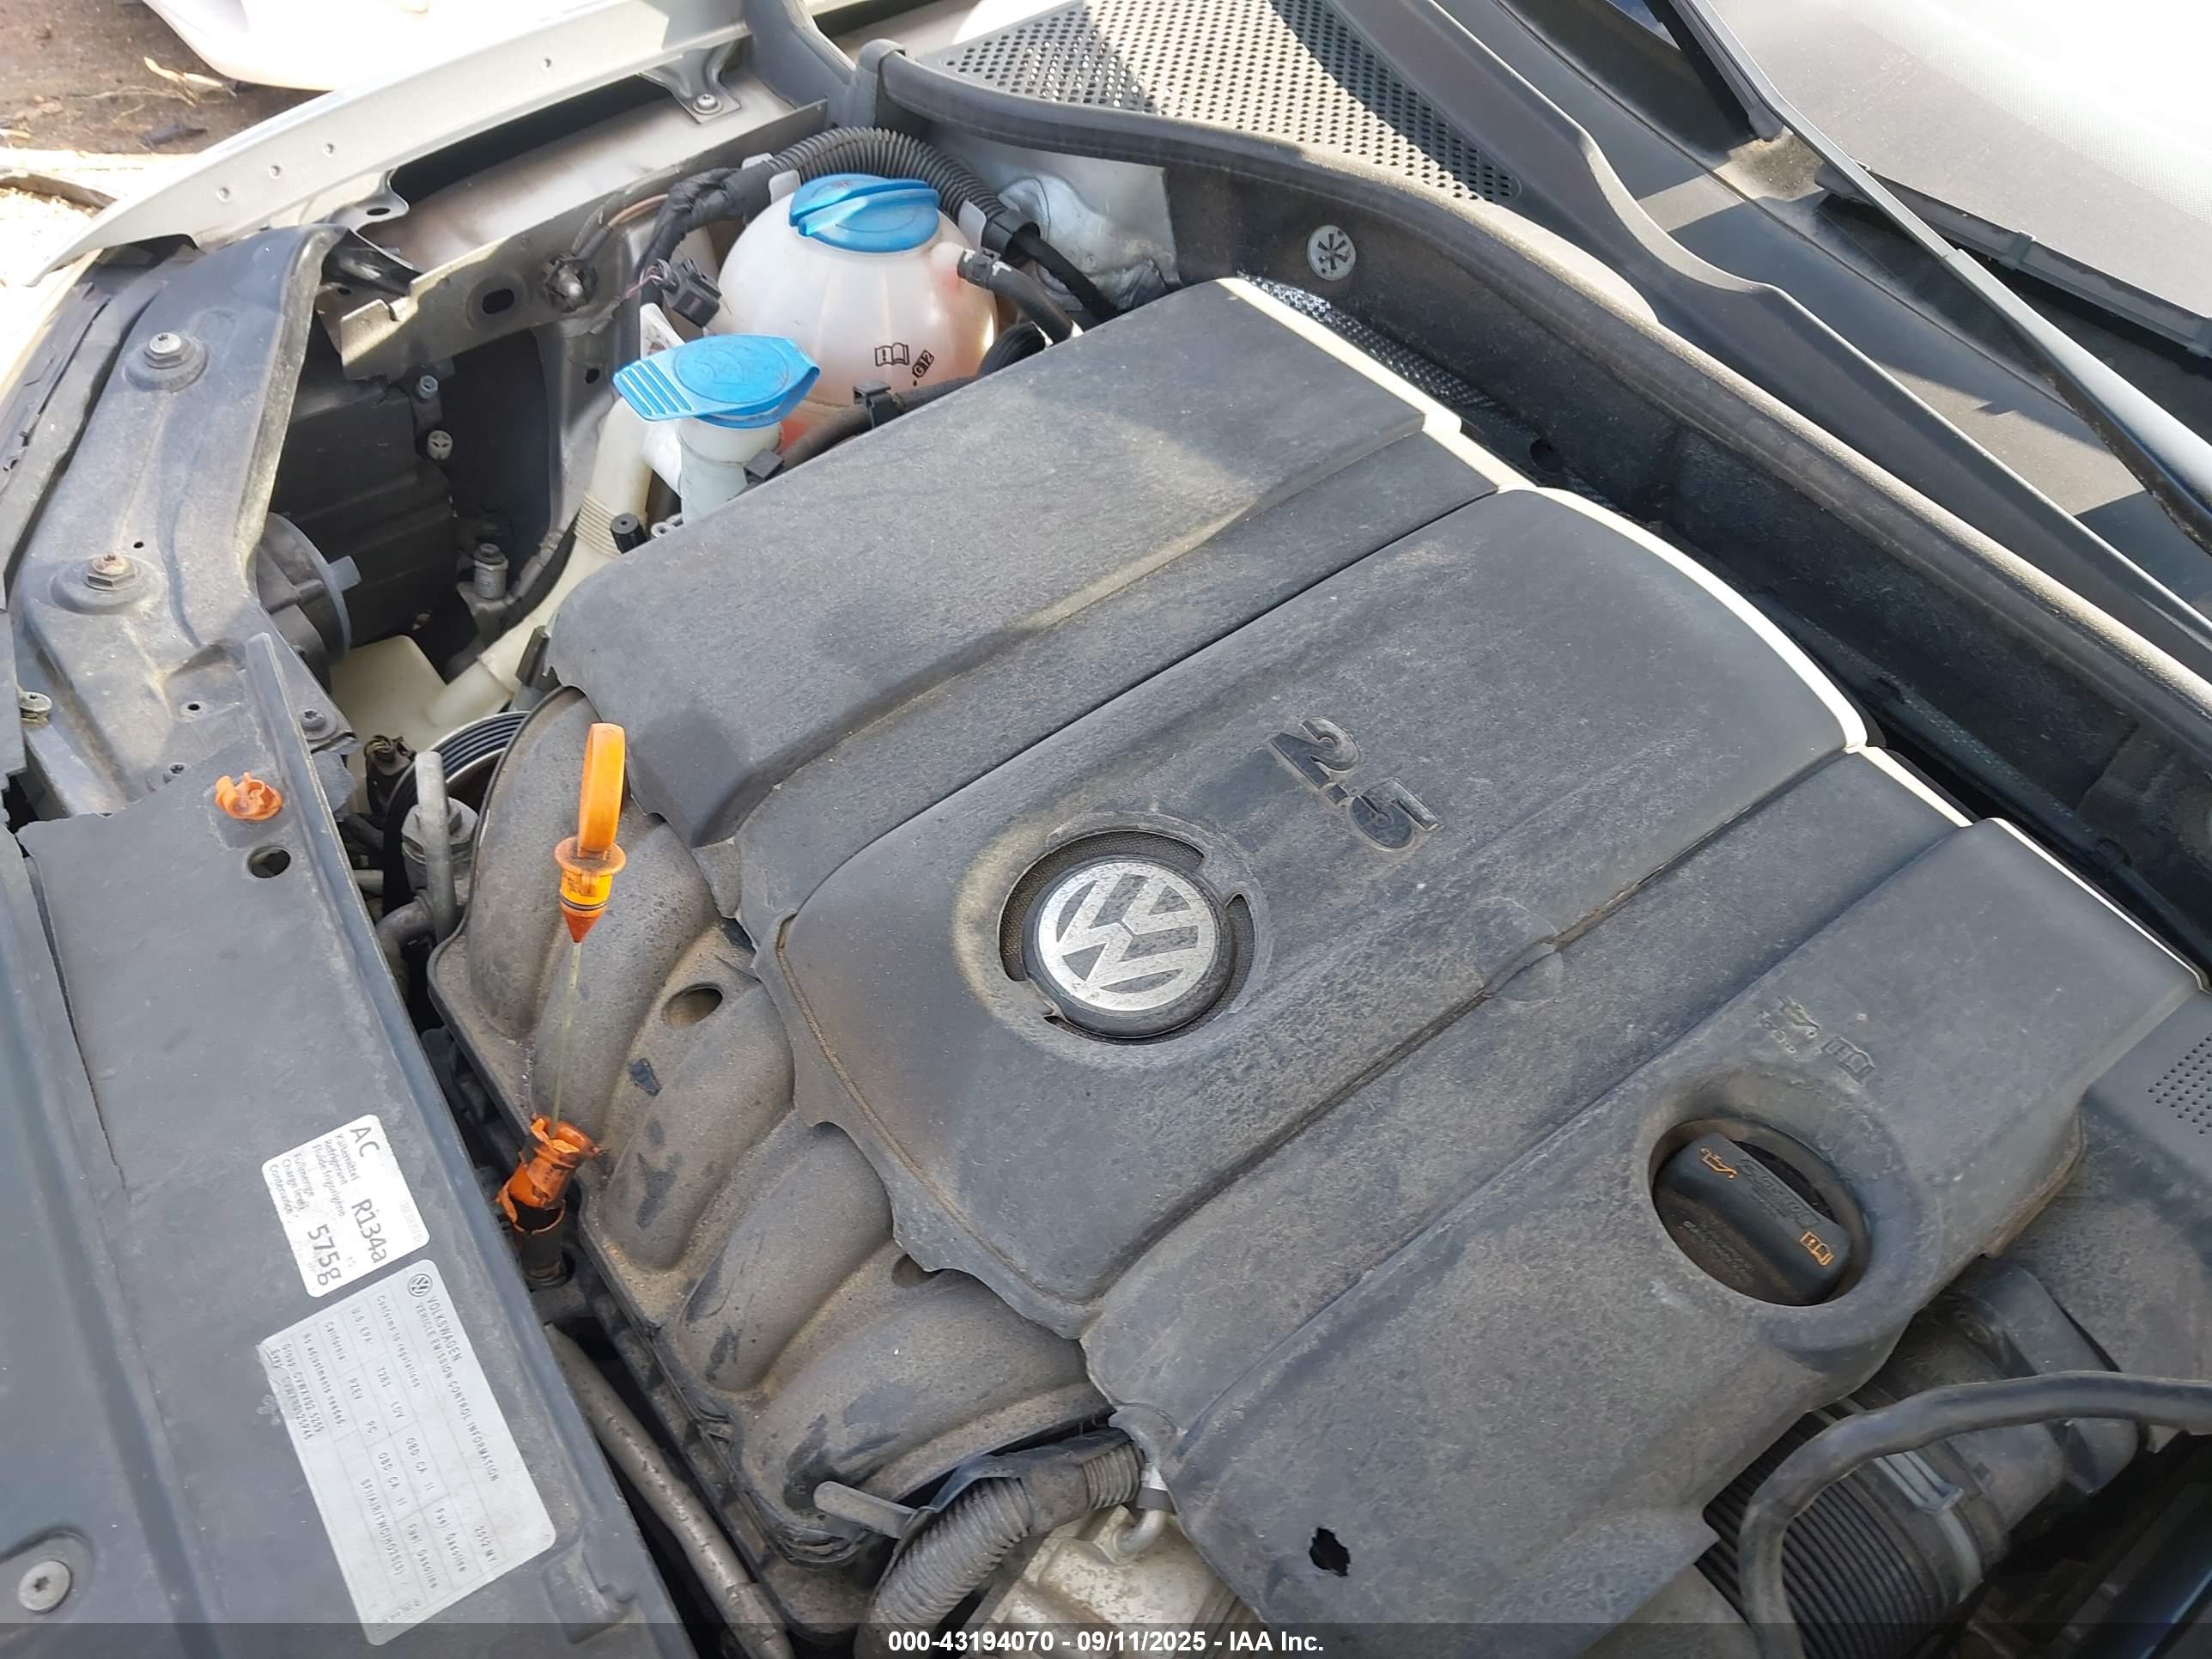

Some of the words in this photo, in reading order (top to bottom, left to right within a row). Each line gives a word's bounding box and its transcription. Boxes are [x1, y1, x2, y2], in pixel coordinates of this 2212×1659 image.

[1270, 716, 1441, 850] 2.5
[349, 1127, 380, 1158] AC
[307, 1223, 342, 1286] 575g
[350, 1198, 387, 1263] R134a
[426, 1295, 463, 1362] VOLKSWAGEN
[415, 1302, 436, 1338] VEHICLE
[430, 1338, 454, 1379] EMISSION
[447, 1380, 472, 1421] CONTROL
[466, 1421, 500, 1482] INFORMATION
